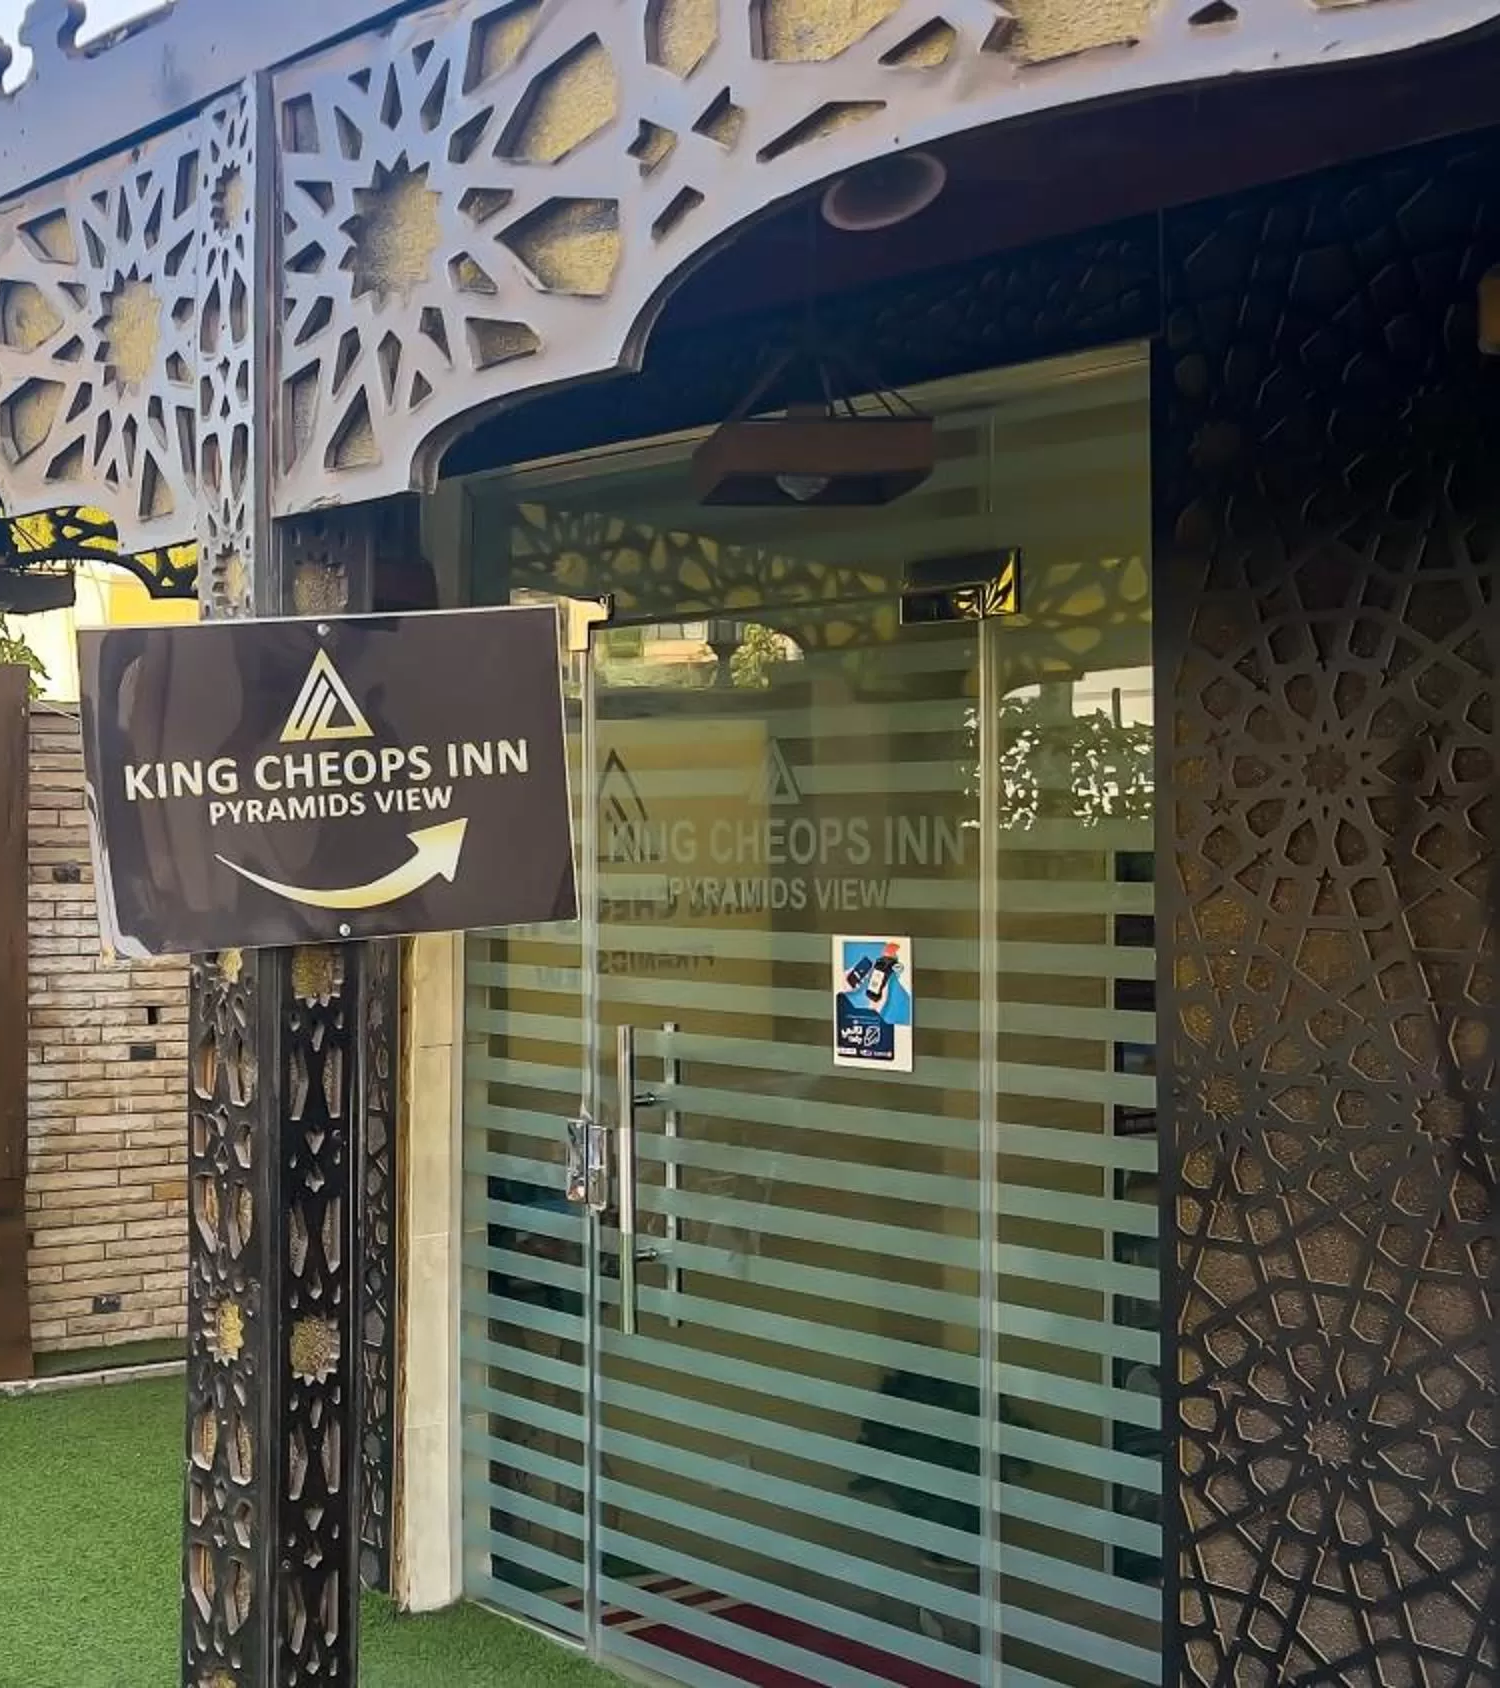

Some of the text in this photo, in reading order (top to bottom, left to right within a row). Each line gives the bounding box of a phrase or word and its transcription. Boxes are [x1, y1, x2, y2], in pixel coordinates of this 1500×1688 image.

[123, 738, 529, 801] KING CHEOPS INN
[209, 786, 453, 826] PYRAMIDS VIEW
[710, 816, 872, 865] CHEOPS
[884, 815, 965, 865] INN
[668, 876, 892, 911] PYRAMIDS VIEW
